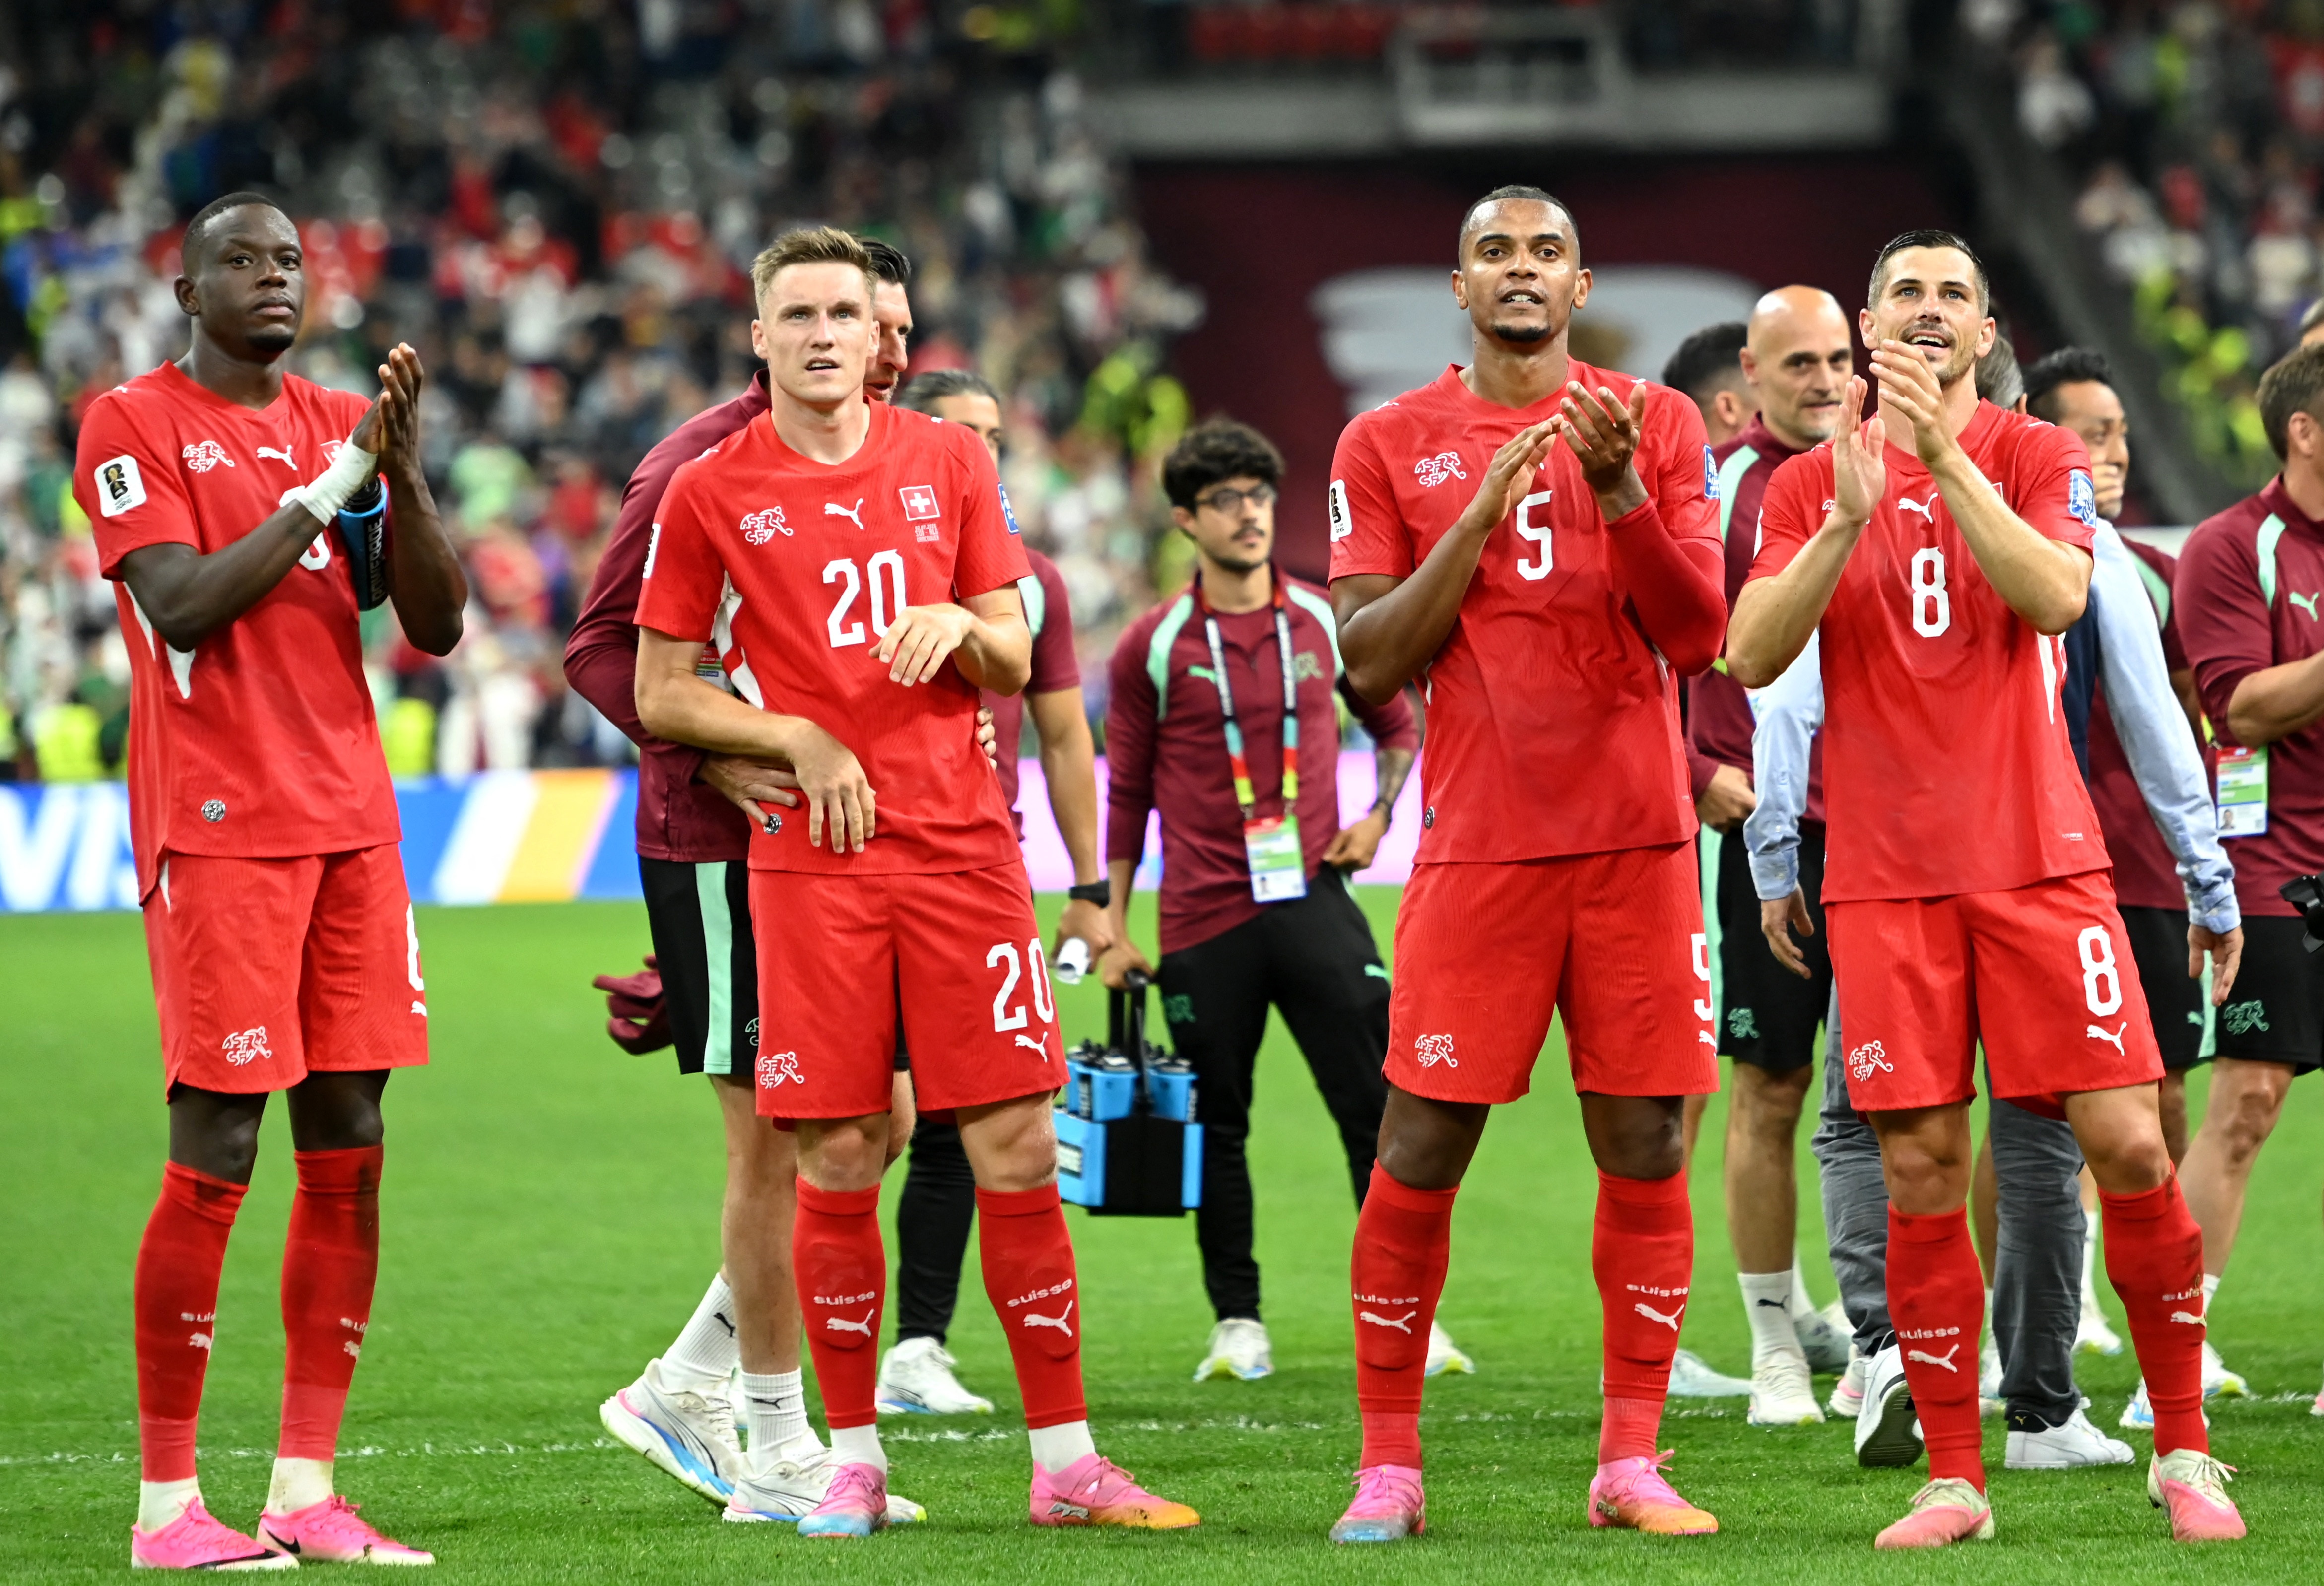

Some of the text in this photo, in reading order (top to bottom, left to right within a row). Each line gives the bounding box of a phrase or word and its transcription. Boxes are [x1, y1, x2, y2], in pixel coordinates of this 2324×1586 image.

[1516, 490, 1553, 581] 5
[822, 549, 907, 648] 20
[1911, 547, 1950, 638] 8
[986, 938, 1054, 1033] 20
[2077, 925, 2123, 1017] 8
[813, 1291, 875, 1305] suisse
[1007, 1278, 1072, 1307] suisse
[1899, 1326, 1960, 1339] suisse
